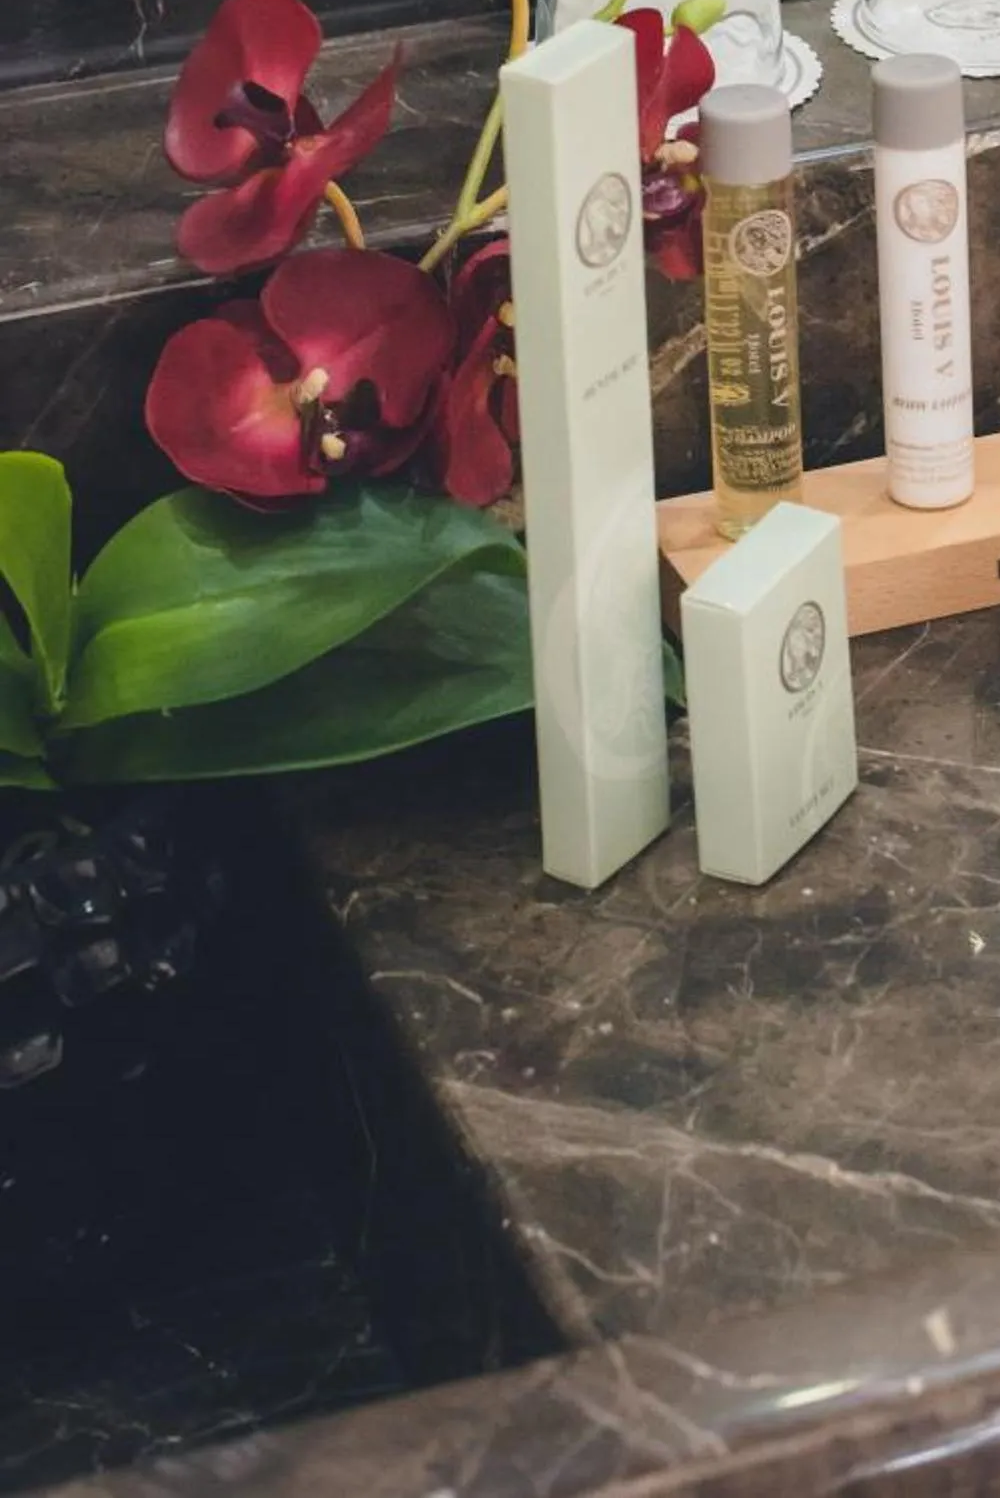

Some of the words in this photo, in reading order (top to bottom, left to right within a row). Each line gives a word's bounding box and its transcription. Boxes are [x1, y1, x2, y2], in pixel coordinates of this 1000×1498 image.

[931, 255, 954, 351] LOUIS
[767, 286, 789, 381] LOUIS
[770, 384, 790, 408] V
[935, 358, 956, 378] V
